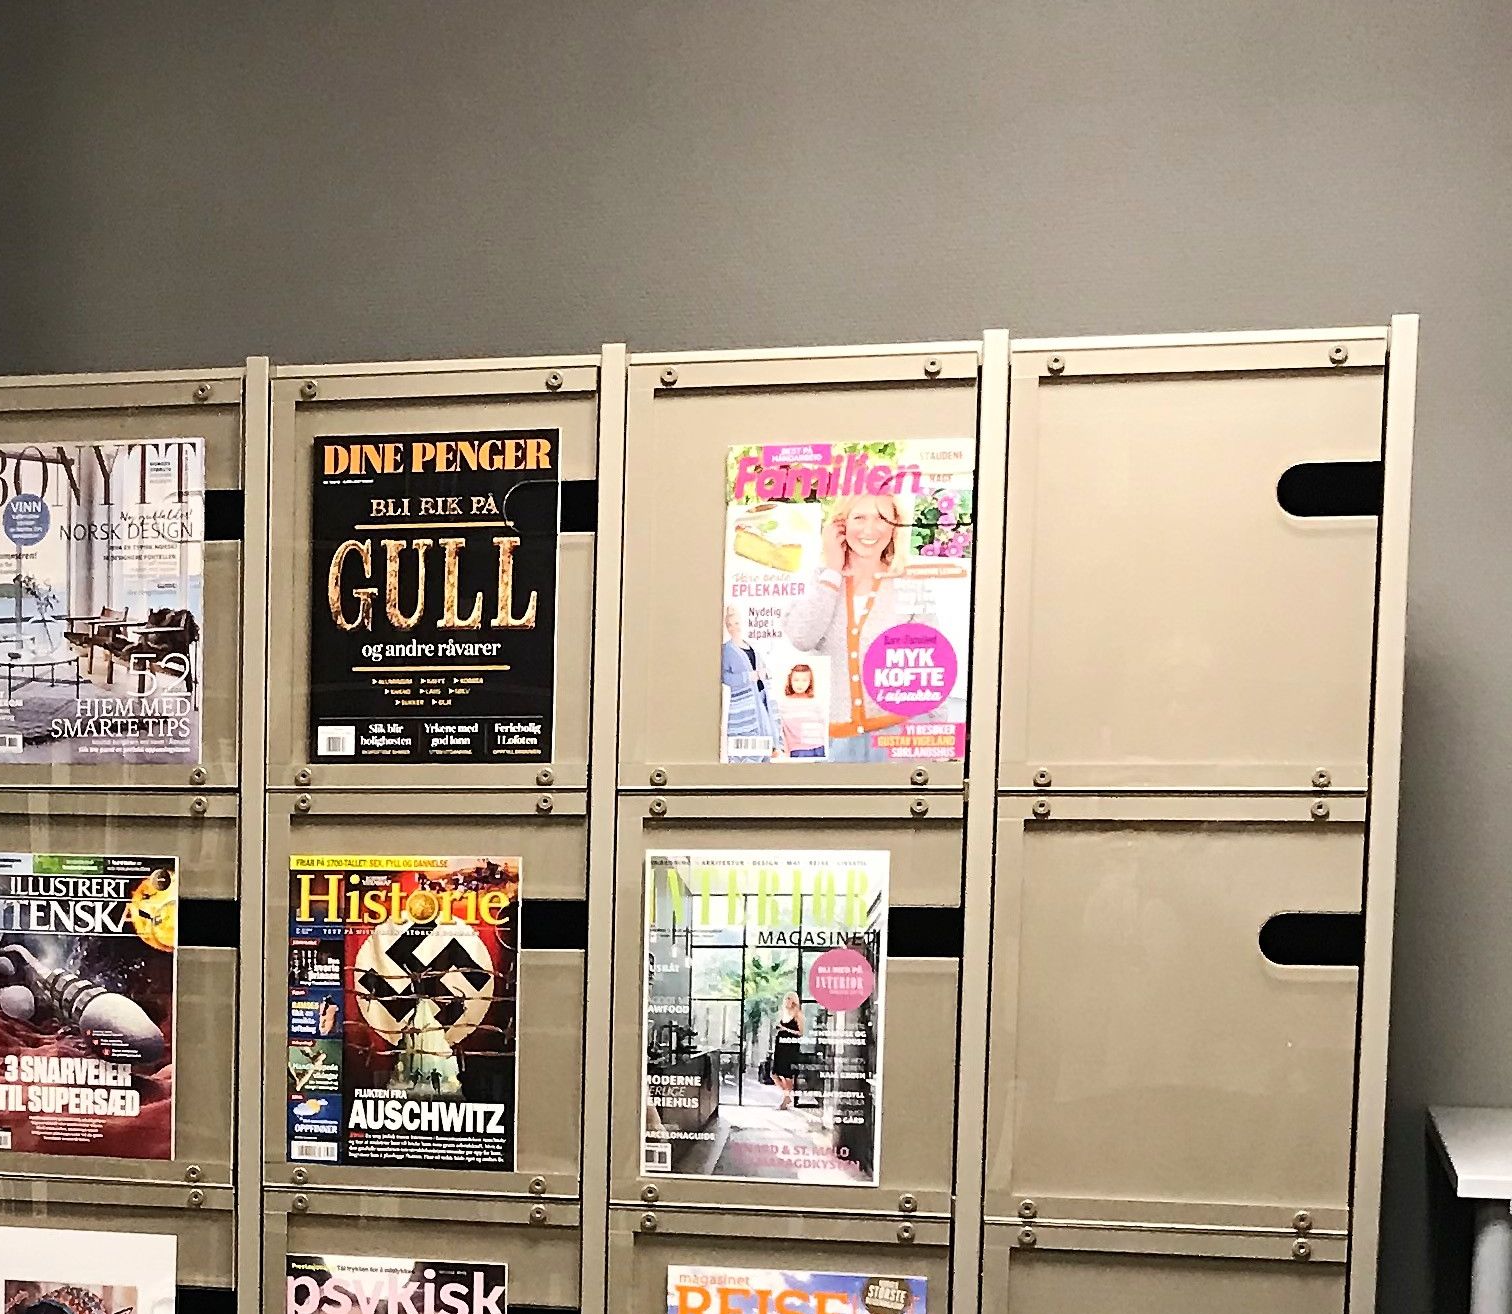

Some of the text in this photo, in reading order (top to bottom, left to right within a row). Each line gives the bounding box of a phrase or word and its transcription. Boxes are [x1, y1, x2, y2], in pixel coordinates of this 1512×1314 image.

[324, 438, 552, 475] DINE PENGER
[734, 452, 924, 499] Familien
[10, 502, 42, 513] VINN
[370, 492, 500, 517] BLI RIK PÅ
[59, 523, 122, 541] NORSK
[127, 521, 193, 539] DESIGN
[327, 536, 538, 632] GULL
[731, 583, 806, 598] EPLEKAKER
[361, 638, 501, 661] og andre råvarer
[885, 647, 935, 667] MYK
[126, 653, 191, 698] 52
[874, 667, 945, 687] KOFTE
[76, 698, 191, 719] HJEM MED
[51, 718, 191, 738] SMARTE TIPS
[10, 876, 130, 899] ILLUSTRERT
[296, 873, 511, 925] Historie
[758, 931, 878, 946] MAGASINET
[4, 1054, 133, 1087] 3 SNARVEIER
[28, 1086, 142, 1117] SUPERSÆD
[391, 1089, 408, 1100] FRA
[647, 1097, 700, 1109] ERIEHUS
[348, 1100, 505, 1134] AUSCHWITZ
[679, 1273, 750, 1288] magasinet
